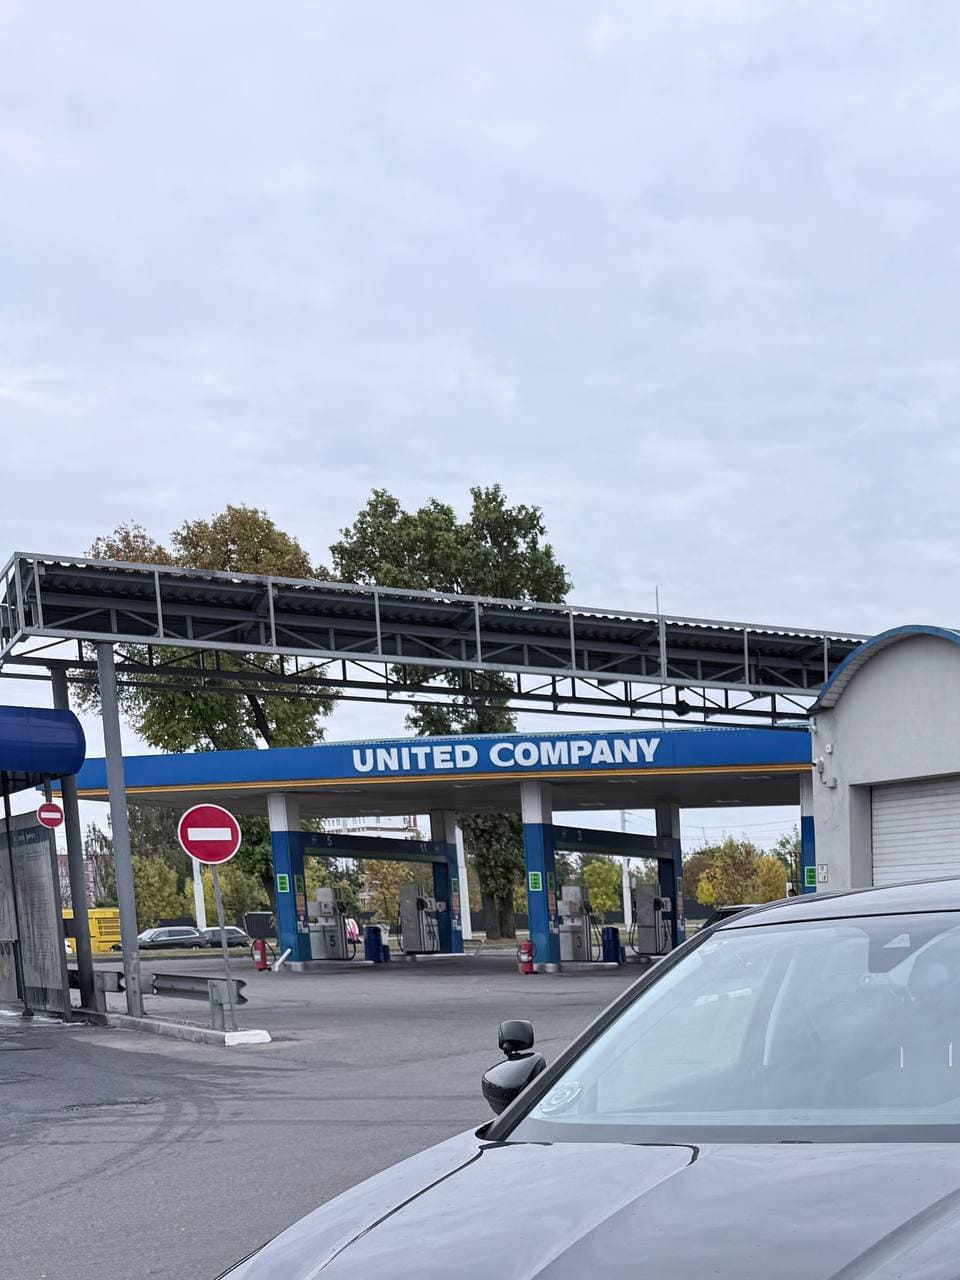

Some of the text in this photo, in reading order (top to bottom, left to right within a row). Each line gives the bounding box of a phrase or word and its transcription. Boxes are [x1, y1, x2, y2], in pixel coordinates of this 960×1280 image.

[353, 738, 660, 772] UNITED COMPANY
[329, 935, 337, 948] 5
[576, 936, 583, 949] 3
